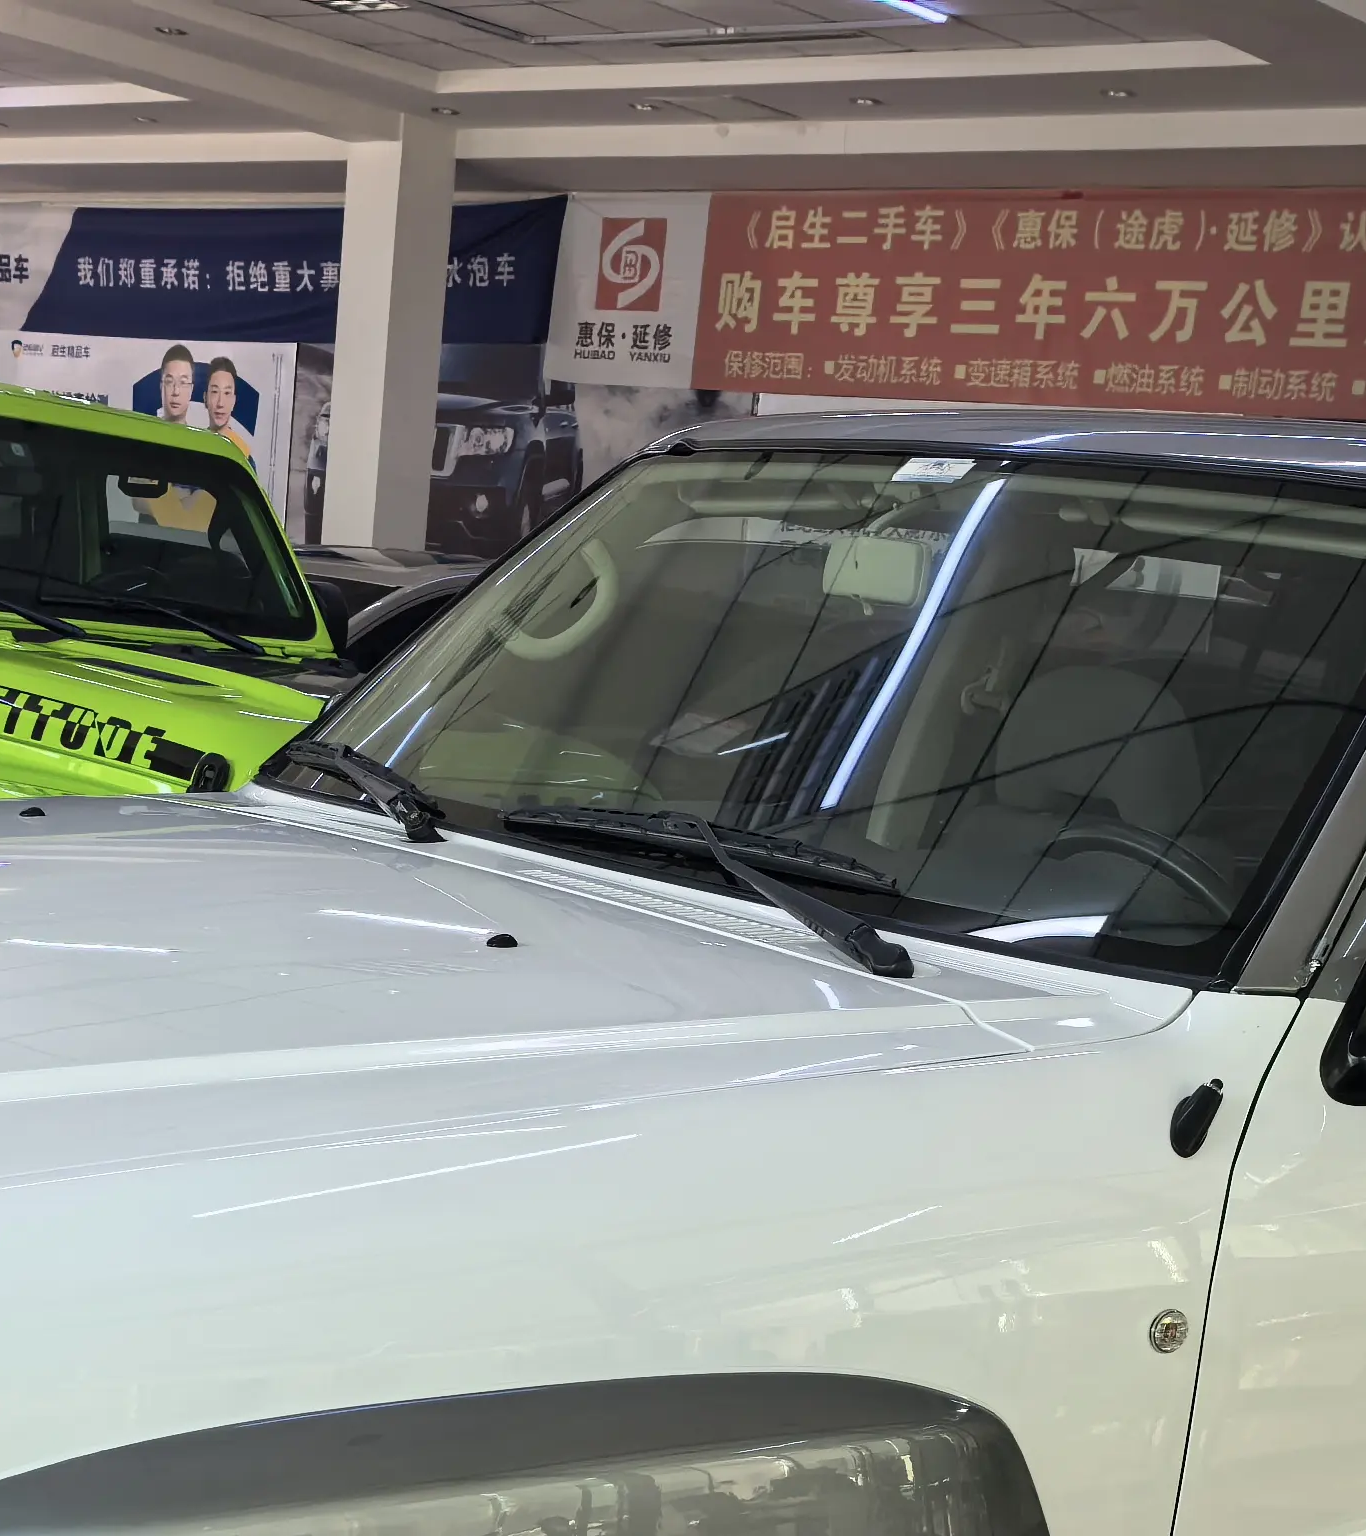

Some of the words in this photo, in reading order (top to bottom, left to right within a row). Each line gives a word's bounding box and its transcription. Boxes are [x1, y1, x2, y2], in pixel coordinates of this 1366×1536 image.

[575, 320, 673, 351] 惠保·延修
[629, 351, 671, 363] YANXIU
